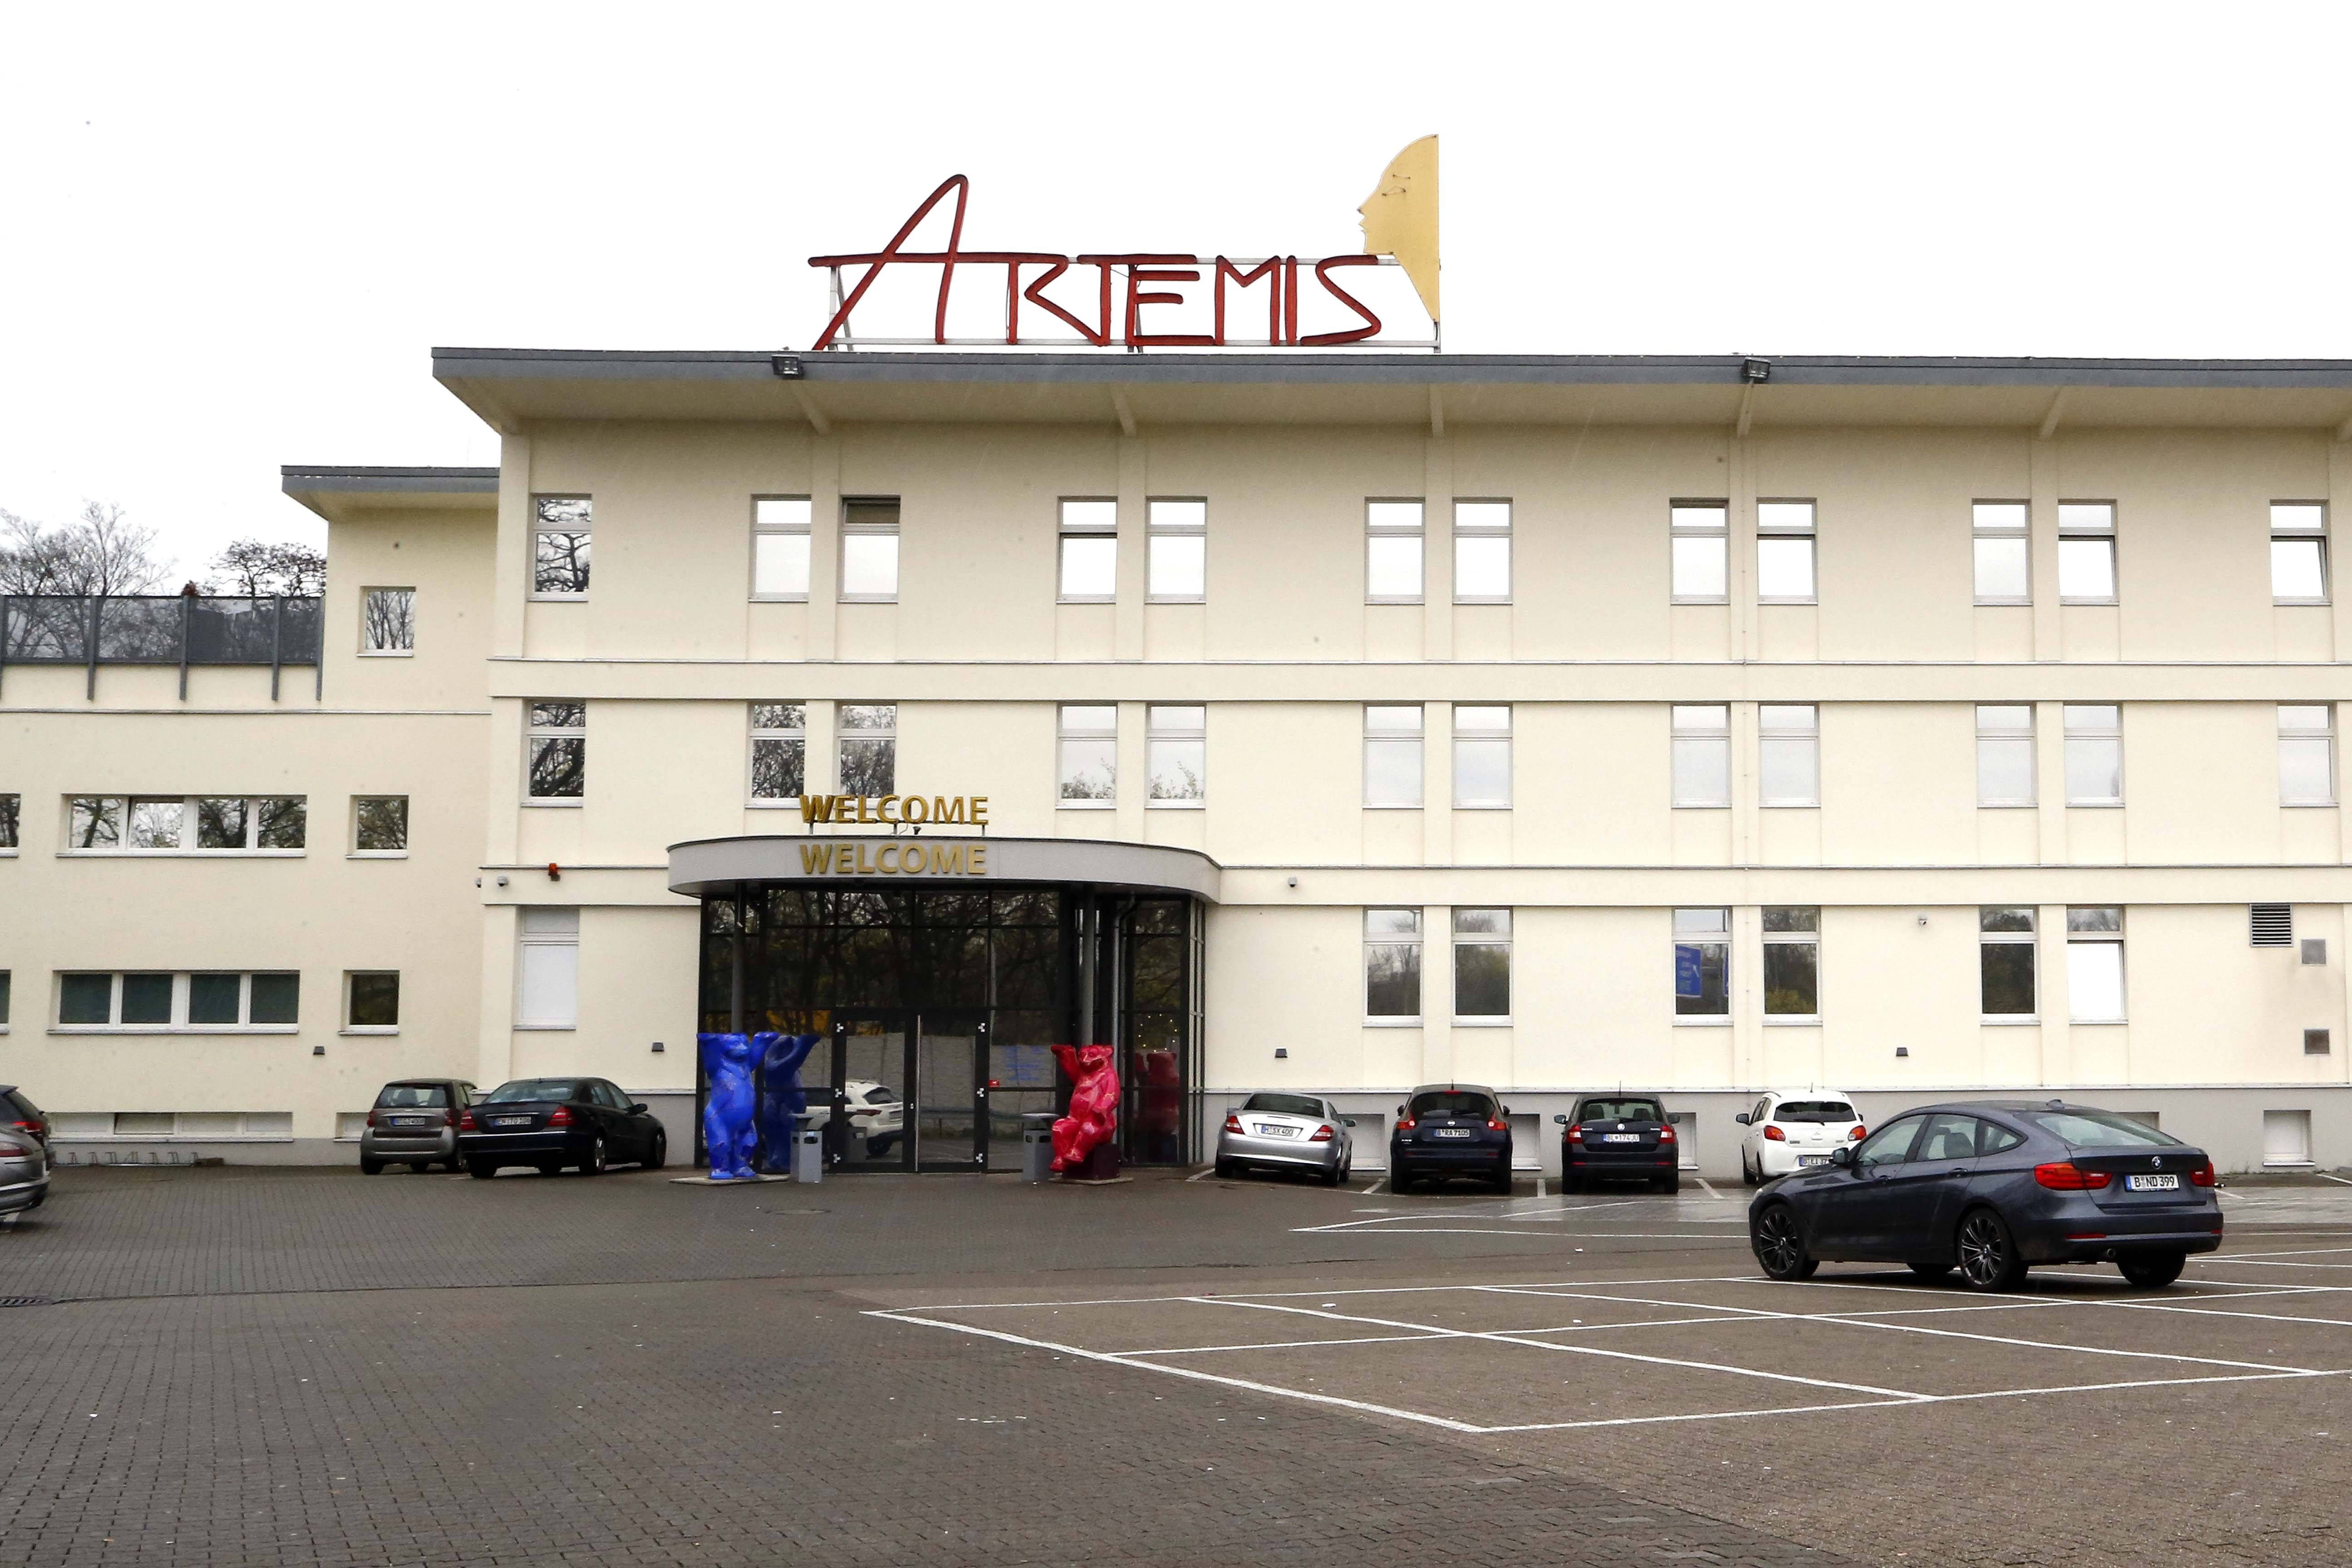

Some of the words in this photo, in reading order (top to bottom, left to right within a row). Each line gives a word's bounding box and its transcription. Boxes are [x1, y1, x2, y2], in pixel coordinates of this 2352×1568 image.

[808, 174, 1381, 351] ARTEMIS
[799, 794, 989, 825] WELCOME
[799, 843, 986, 874] WELCOME
[2134, 1177, 2141, 1187] B
[2145, 1176, 2158, 1187] ND
[2159, 1176, 2175, 1187] 399
